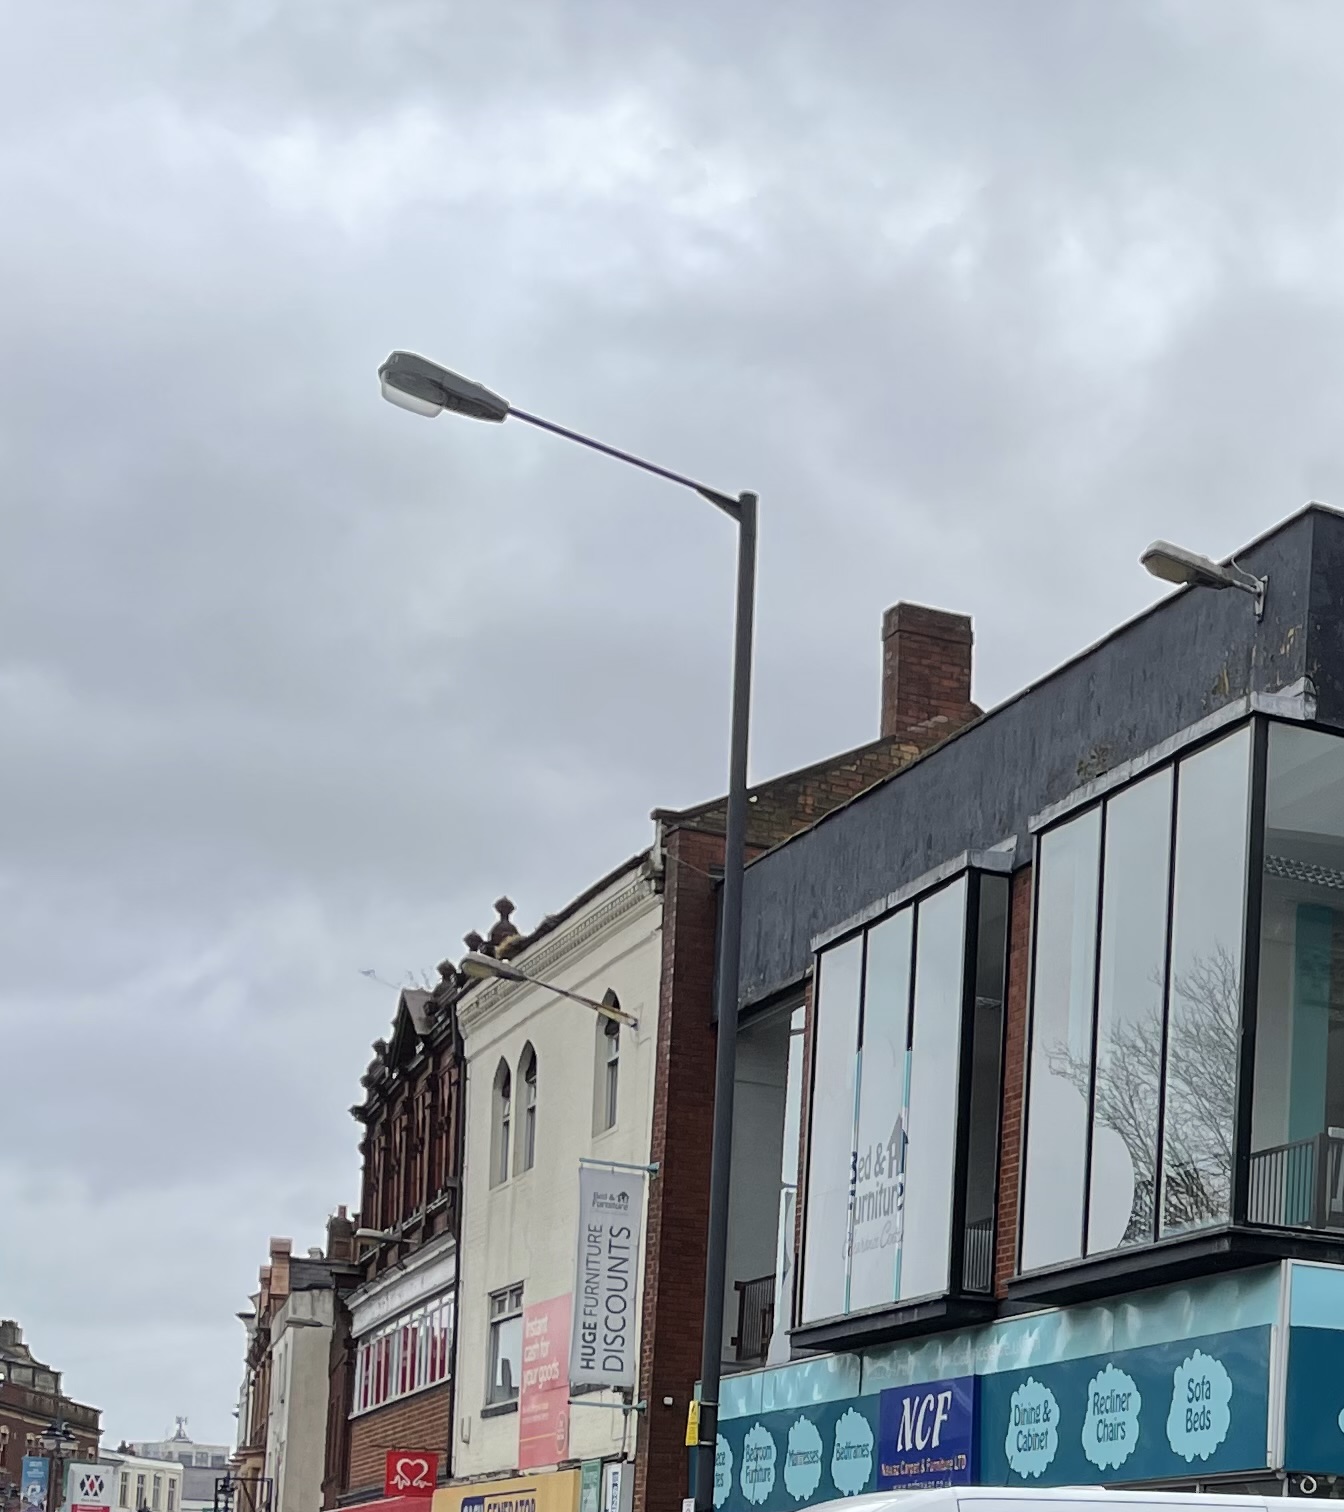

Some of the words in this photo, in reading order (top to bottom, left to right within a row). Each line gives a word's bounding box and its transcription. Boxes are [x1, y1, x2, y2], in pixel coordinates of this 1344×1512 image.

[584, 1223, 603, 1317] FURNITURE
[602, 1225, 631, 1373] DISCOUNTS
[580, 1321, 598, 1371] HUGE
[1092, 1388, 1132, 1416] Recliner
[1186, 1375, 1211, 1404] Sofa
[896, 1390, 952, 1453] NCF
[1014, 1401, 1041, 1427] Dining
[1043, 1399, 1051, 1424] &
[1185, 1408, 1212, 1434] Beds
[1016, 1427, 1049, 1453] Cabinet
[1096, 1416, 1126, 1443] Chairs
